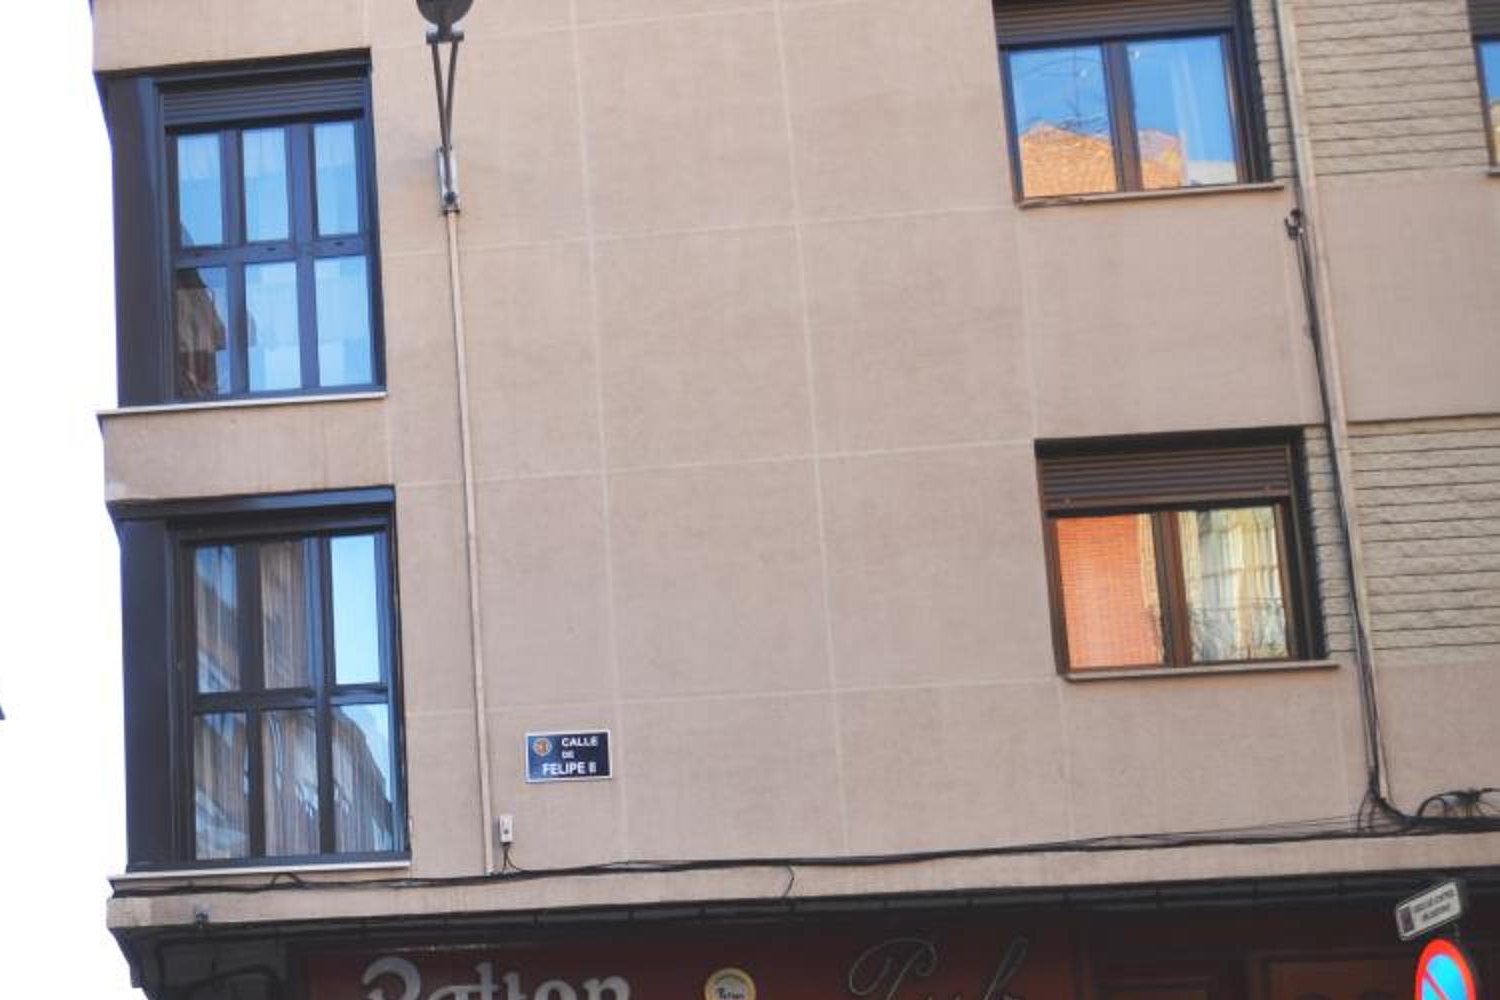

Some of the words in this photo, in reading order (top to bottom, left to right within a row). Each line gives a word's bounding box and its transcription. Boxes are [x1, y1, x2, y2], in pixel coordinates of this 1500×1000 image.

[561, 737, 598, 747] CALLE
[561, 750, 575, 759] DE
[542, 762, 586, 775] FELIPE
